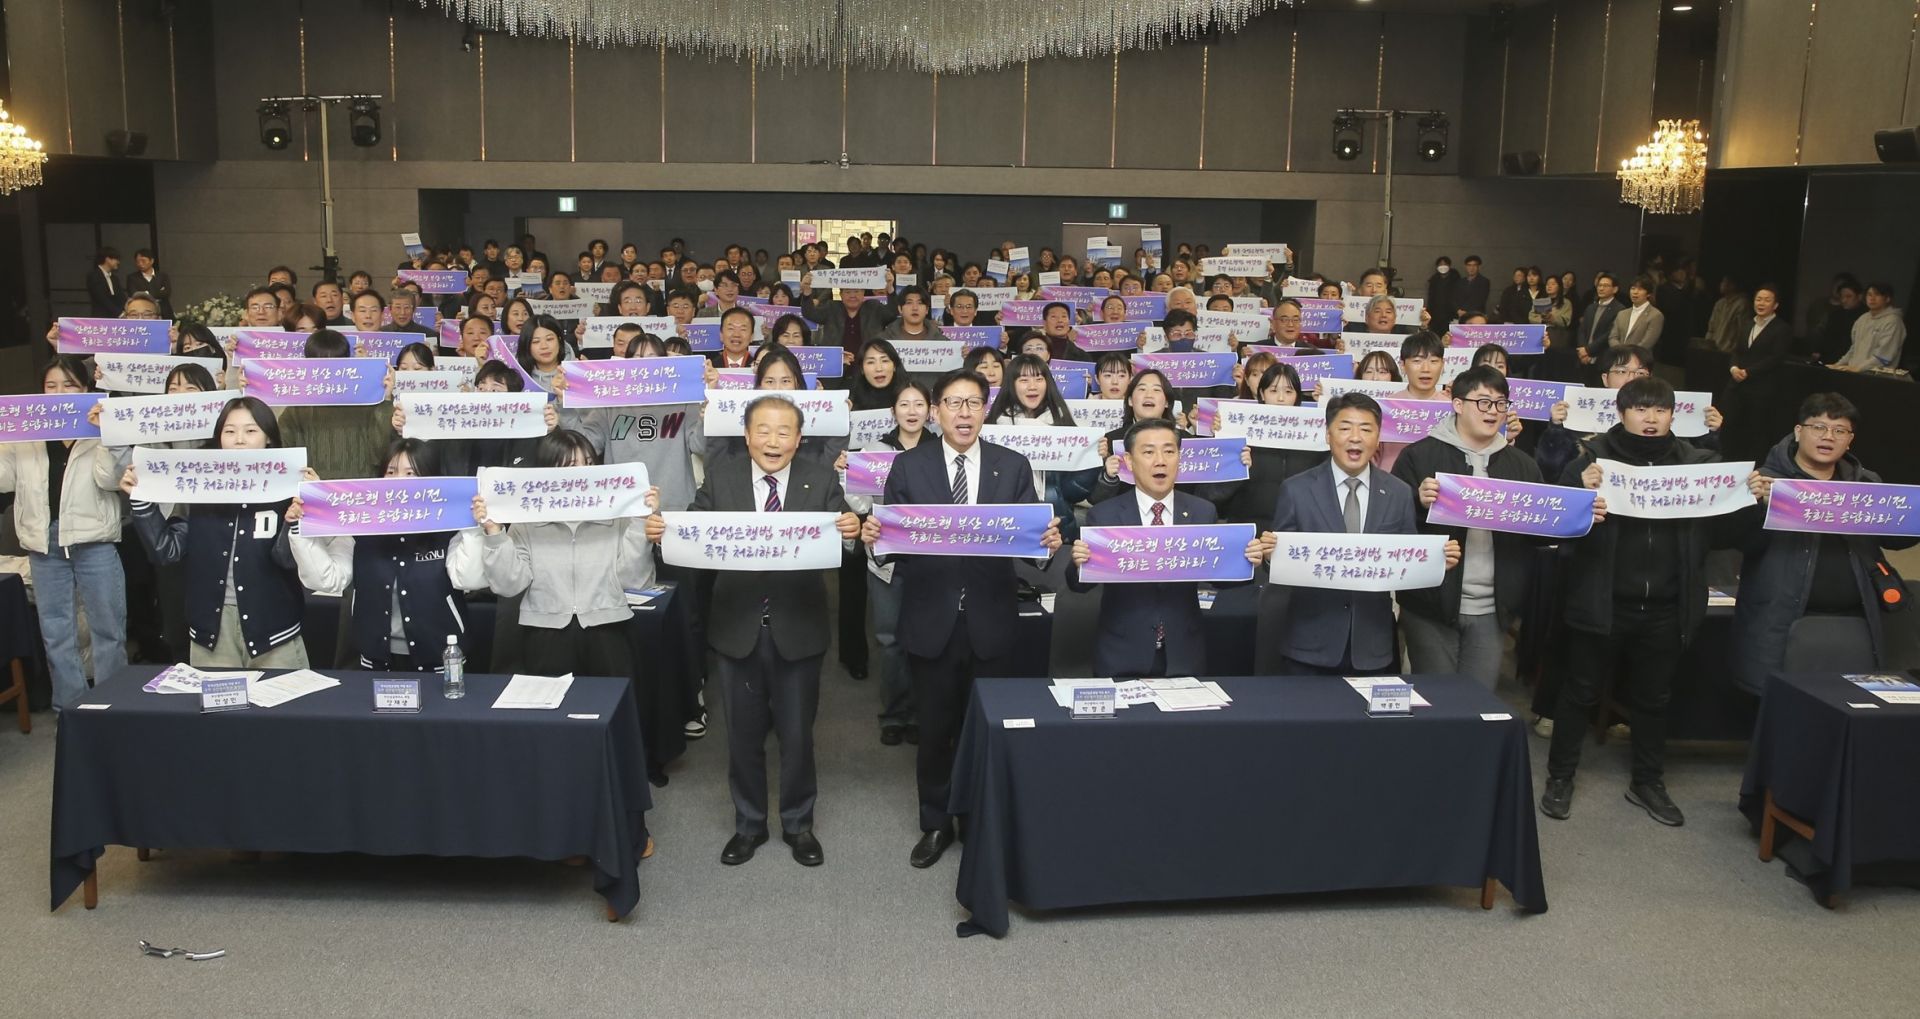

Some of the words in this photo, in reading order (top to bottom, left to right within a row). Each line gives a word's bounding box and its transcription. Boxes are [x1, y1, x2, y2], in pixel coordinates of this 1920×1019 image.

[75, 326, 107, 335] 산업은행
[111, 326, 126, 335] 부산
[81, 337, 103, 347] 국회는
[107, 337, 140, 347] 응답하라
[252, 338, 288, 350] 산업은행
[106, 362, 123, 372] 한국
[1147, 359, 1179, 369] 산업은행
[1182, 359, 1196, 369] 부산
[126, 374, 143, 385] 즉각
[263, 367, 306, 380] 산업은행
[311, 367, 332, 380] 부산
[583, 367, 626, 381] 산업은행
[630, 367, 650, 380] 부산
[272, 383, 301, 398] 국회는
[305, 384, 349, 395] 응답하라
[420, 380, 448, 389] 개정안
[593, 384, 621, 399] 국회는
[624, 383, 668, 396] 응답하라
[1515, 387, 1531, 398] 부산
[25, 403, 47, 418] 부산
[414, 403, 433, 416] 한국
[437, 402, 492, 415] 산업은행법
[496, 403, 532, 414] 개정안
[718, 400, 737, 413] 한국
[799, 400, 833, 411] 개정안
[1577, 397, 1597, 410] 한국
[114, 407, 134, 421] 한국
[138, 403, 197, 418] 산업은행법
[1073, 408, 1088, 420] 한국
[1228, 411, 1245, 425] 한국
[1249, 413, 1300, 427] 산업은행법
[1389, 409, 1430, 421] 산업은행
[1596, 411, 1616, 425] 즉각
[21, 417, 67, 432] 응답하라
[138, 420, 160, 434] 즉각
[163, 418, 210, 431] 처리하라
[437, 417, 456, 430] 즉각
[461, 418, 505, 429] 처리하라
[1396, 422, 1421, 434] 국회는
[1000, 434, 1052, 447] 산업은행법
[1056, 435, 1089, 447] 개정안
[1246, 426, 1264, 441] 즉각
[1268, 428, 1308, 440] 처리하라
[147, 460, 169, 475] 한국
[174, 460, 241, 475] 산업은행법
[245, 460, 289, 475] 개정안
[174, 476, 198, 493] 즉각
[203, 478, 257, 491] 처리하라
[493, 480, 517, 495] 한국
[521, 478, 589, 493] 산업은행법
[594, 476, 636, 490] 개정안
[1609, 472, 1626, 489] 한국
[1629, 477, 1688, 491] 산업은행법
[1694, 475, 1737, 488] 개정안
[326, 489, 379, 506] 산업은행
[385, 489, 409, 506] 부산
[519, 495, 544, 512] 즉각
[549, 495, 602, 509] 처리하라
[1459, 487, 1506, 504] 산업은행
[1510, 492, 1533, 508] 부산
[1629, 492, 1645, 509] 즉각
[1650, 494, 1703, 507] 처리하라
[1795, 490, 1846, 506] 산업은행
[1850, 493, 1874, 508] 부산
[337, 510, 372, 525] 국회는
[377, 507, 430, 524] 응답하라
[1465, 505, 1494, 520] 국회는
[1499, 509, 1548, 524] 응답하라
[1803, 508, 1835, 523] 국회는
[1840, 510, 1892, 524] 응답하라
[253, 510, 279, 539] D
[899, 516, 952, 530] 산업은행
[958, 516, 982, 531] 부산
[678, 525, 701, 542] 한국
[706, 524, 773, 541] 산업은행법
[779, 525, 822, 541] 개정안
[909, 530, 943, 545] 국회는
[948, 531, 1001, 545] 응답하라
[703, 544, 728, 560] 즉각
[732, 544, 788, 558] 처리하라
[1107, 537, 1157, 553] 산업은행
[1164, 537, 1187, 553] 부산
[1288, 544, 1311, 561] 한국
[1315, 545, 1381, 562] 산업은행법
[1387, 548, 1429, 563] 개정안
[1117, 557, 1150, 573] 국회는
[1155, 555, 1207, 570] 응답하라
[1312, 563, 1336, 580] 즉각
[1341, 565, 1394, 579] 처리하라
